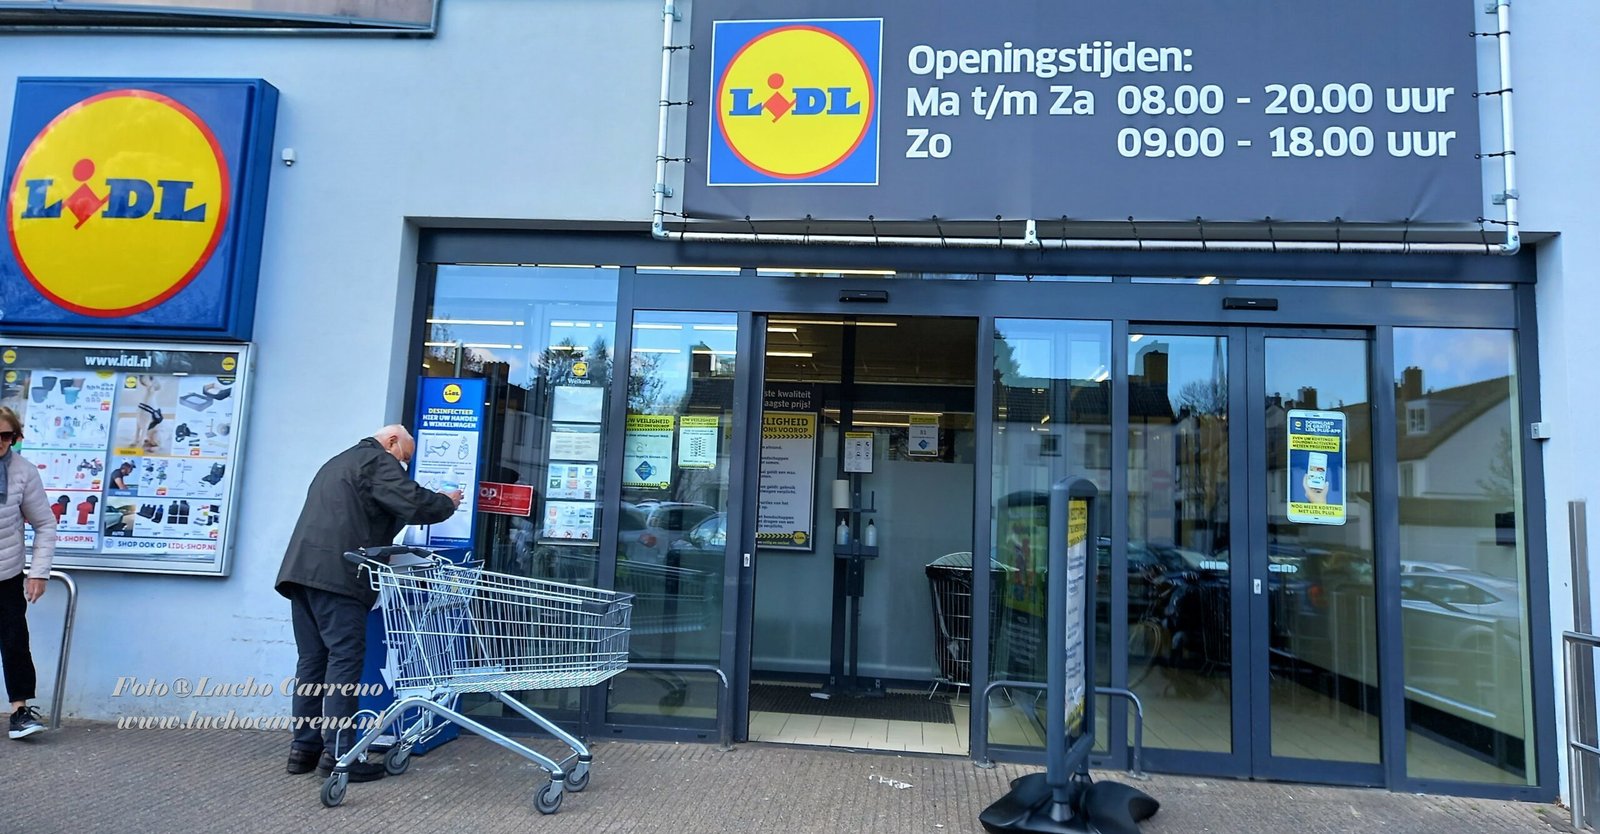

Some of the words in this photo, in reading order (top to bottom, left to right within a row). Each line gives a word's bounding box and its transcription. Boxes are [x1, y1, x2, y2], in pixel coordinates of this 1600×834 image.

[908, 42, 1192, 79] Openingstijden:
[729, 72, 860, 123] LIDL
[906, 87, 960, 116] Ma
[971, 84, 1037, 120] t/m
[1049, 85, 1095, 116] Za
[1117, 84, 1224, 115] 08.00
[1264, 83, 1373, 114] 20.00
[1386, 86, 1454, 113] uur
[906, 129, 952, 158] Zo
[1117, 127, 1224, 158] 09.00
[1269, 125, 1374, 157] 18.00
[1387, 130, 1456, 156] uur
[21, 158, 206, 230] LIDL
[85, 354, 152, 367] www.lidl.nl
[778, 390, 811, 398] kwaliteit
[791, 401, 811, 410] prijs!
